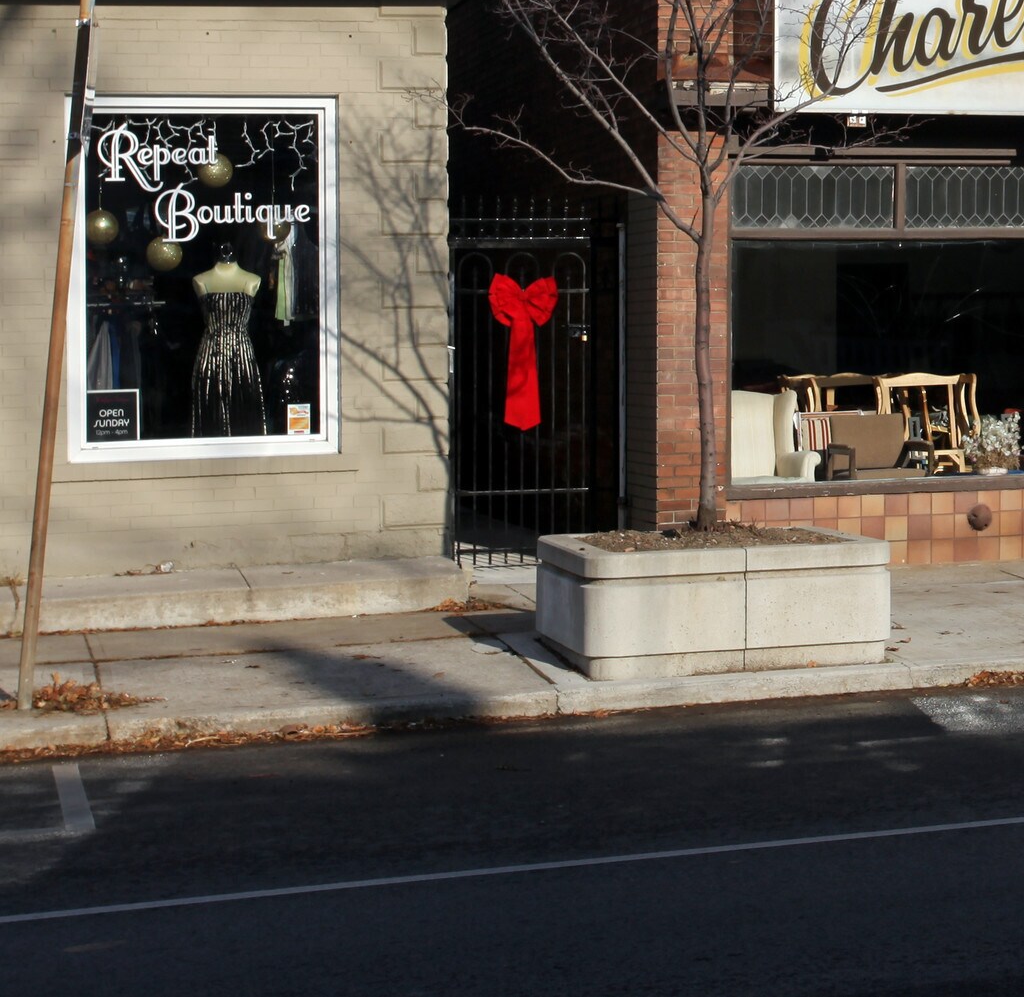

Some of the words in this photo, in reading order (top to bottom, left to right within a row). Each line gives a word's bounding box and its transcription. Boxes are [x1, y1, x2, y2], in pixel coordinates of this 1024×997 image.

[97, 123, 219, 192] Repeat
[154, 182, 312, 243] Boutique
[93, 418, 130, 428] SUNDAY
[99, 408, 124, 418] OPEN
